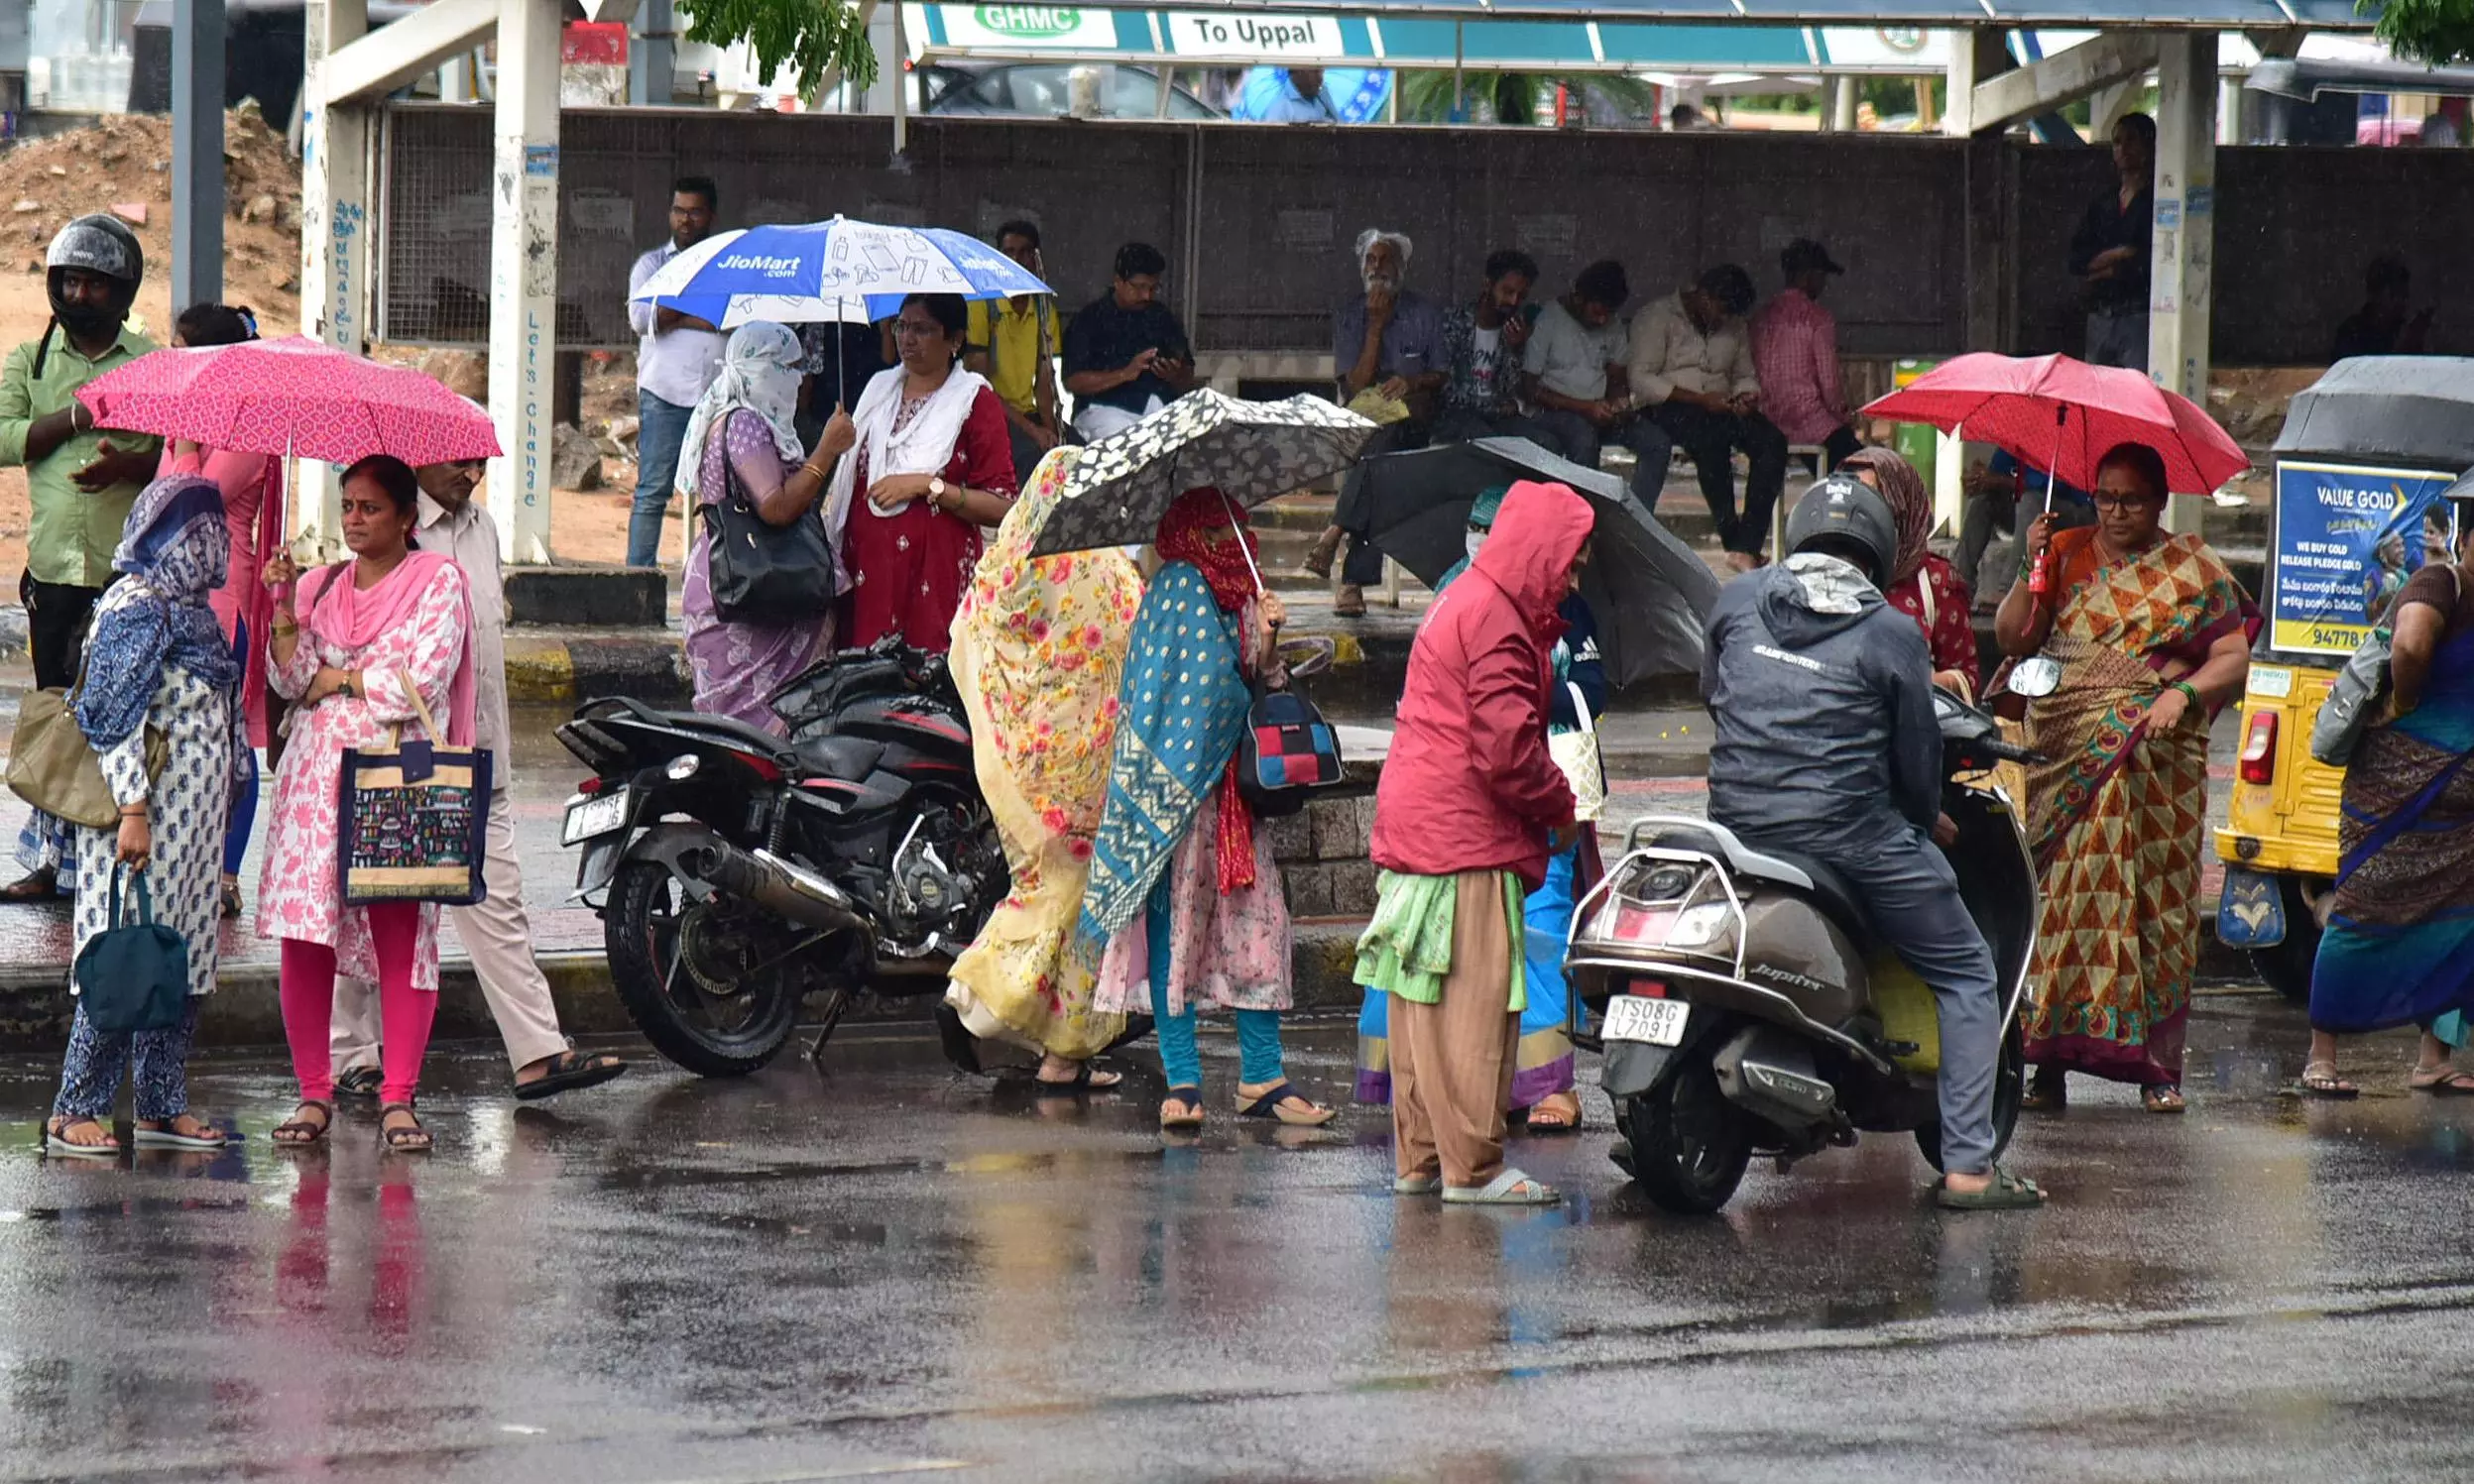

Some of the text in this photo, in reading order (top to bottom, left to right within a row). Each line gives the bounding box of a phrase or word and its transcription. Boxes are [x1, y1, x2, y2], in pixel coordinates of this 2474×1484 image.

[985, 6, 1073, 31] GHMC
[1193, 19, 1315, 50] To Uppal
[718, 255, 801, 270] JioMart
[2317, 486, 2394, 511] VALUE GOLD
[2297, 541, 2348, 555] WE BUY GOLD
[2281, 555, 2312, 567] RELEASE
[2342, 560, 2362, 571] GOLD
[2313, 628, 2359, 647] 94778
[1621, 998, 1678, 1021] TS08G
[1614, 1016, 1670, 1040] L7091
